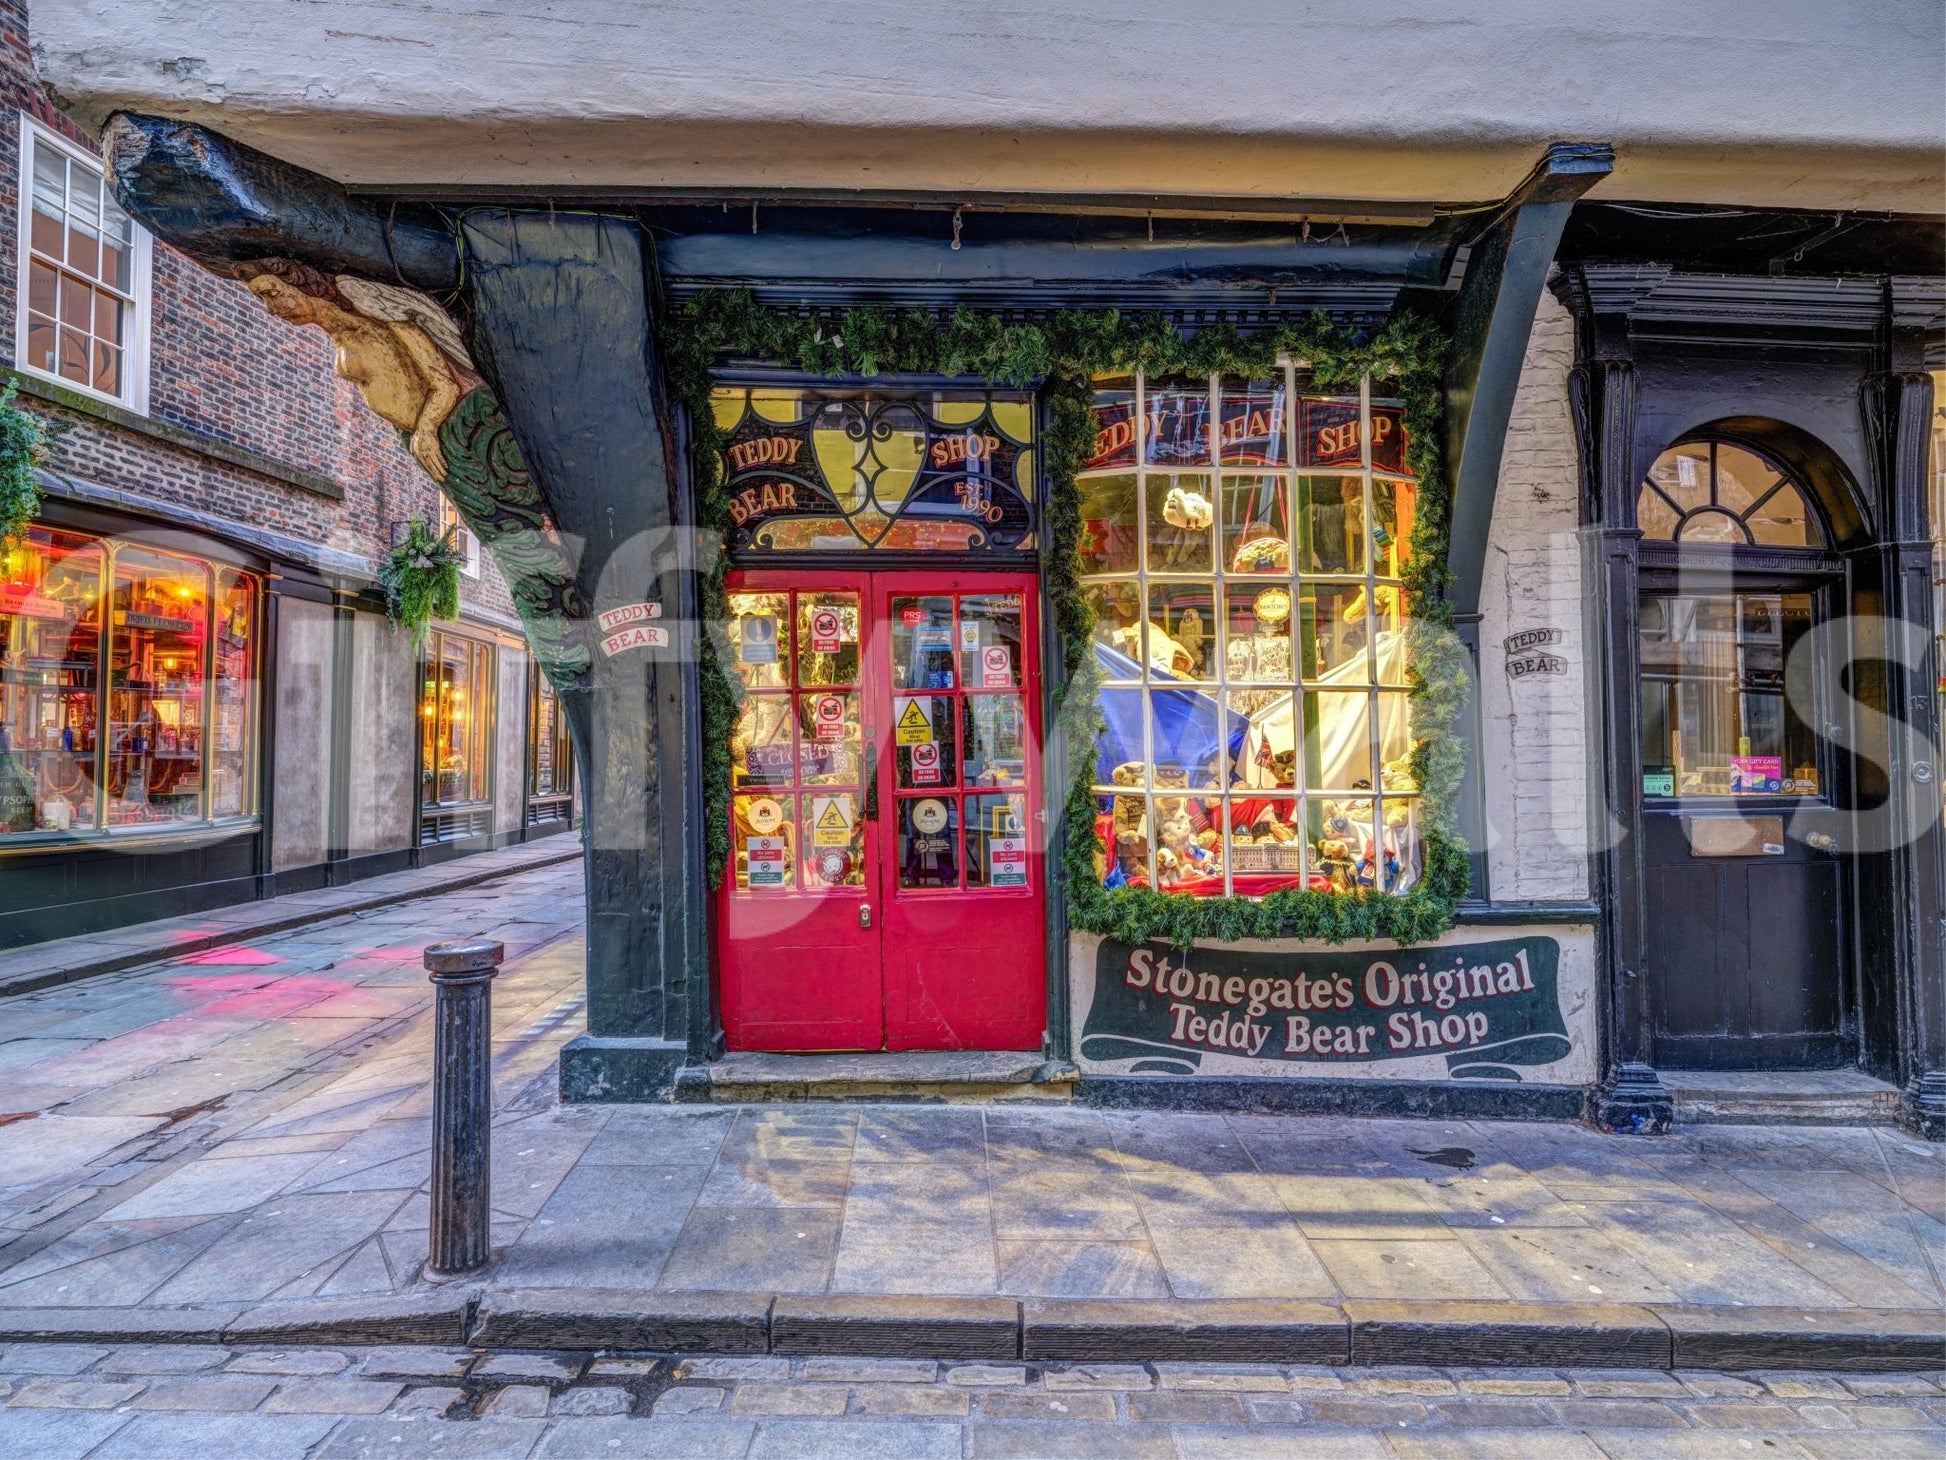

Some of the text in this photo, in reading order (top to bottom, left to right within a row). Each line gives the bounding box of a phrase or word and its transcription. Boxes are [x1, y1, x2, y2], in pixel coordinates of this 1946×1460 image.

[1091, 409, 1169, 460] EDDY
[728, 437, 803, 471] TEDDY
[931, 433, 1000, 469] SHOP
[729, 483, 798, 527] BEAR
[961, 494, 1004, 524] 1990
[603, 604, 655, 627] TEDDY
[903, 610, 921, 620] PRS
[606, 629, 659, 653] BEAR
[1510, 630, 1555, 648] TEDDY
[1512, 658, 1560, 676] BEAR
[1125, 948, 1536, 1017] Stonegate's Original
[1169, 1002, 1489, 1056] Teddy Bear Shop
